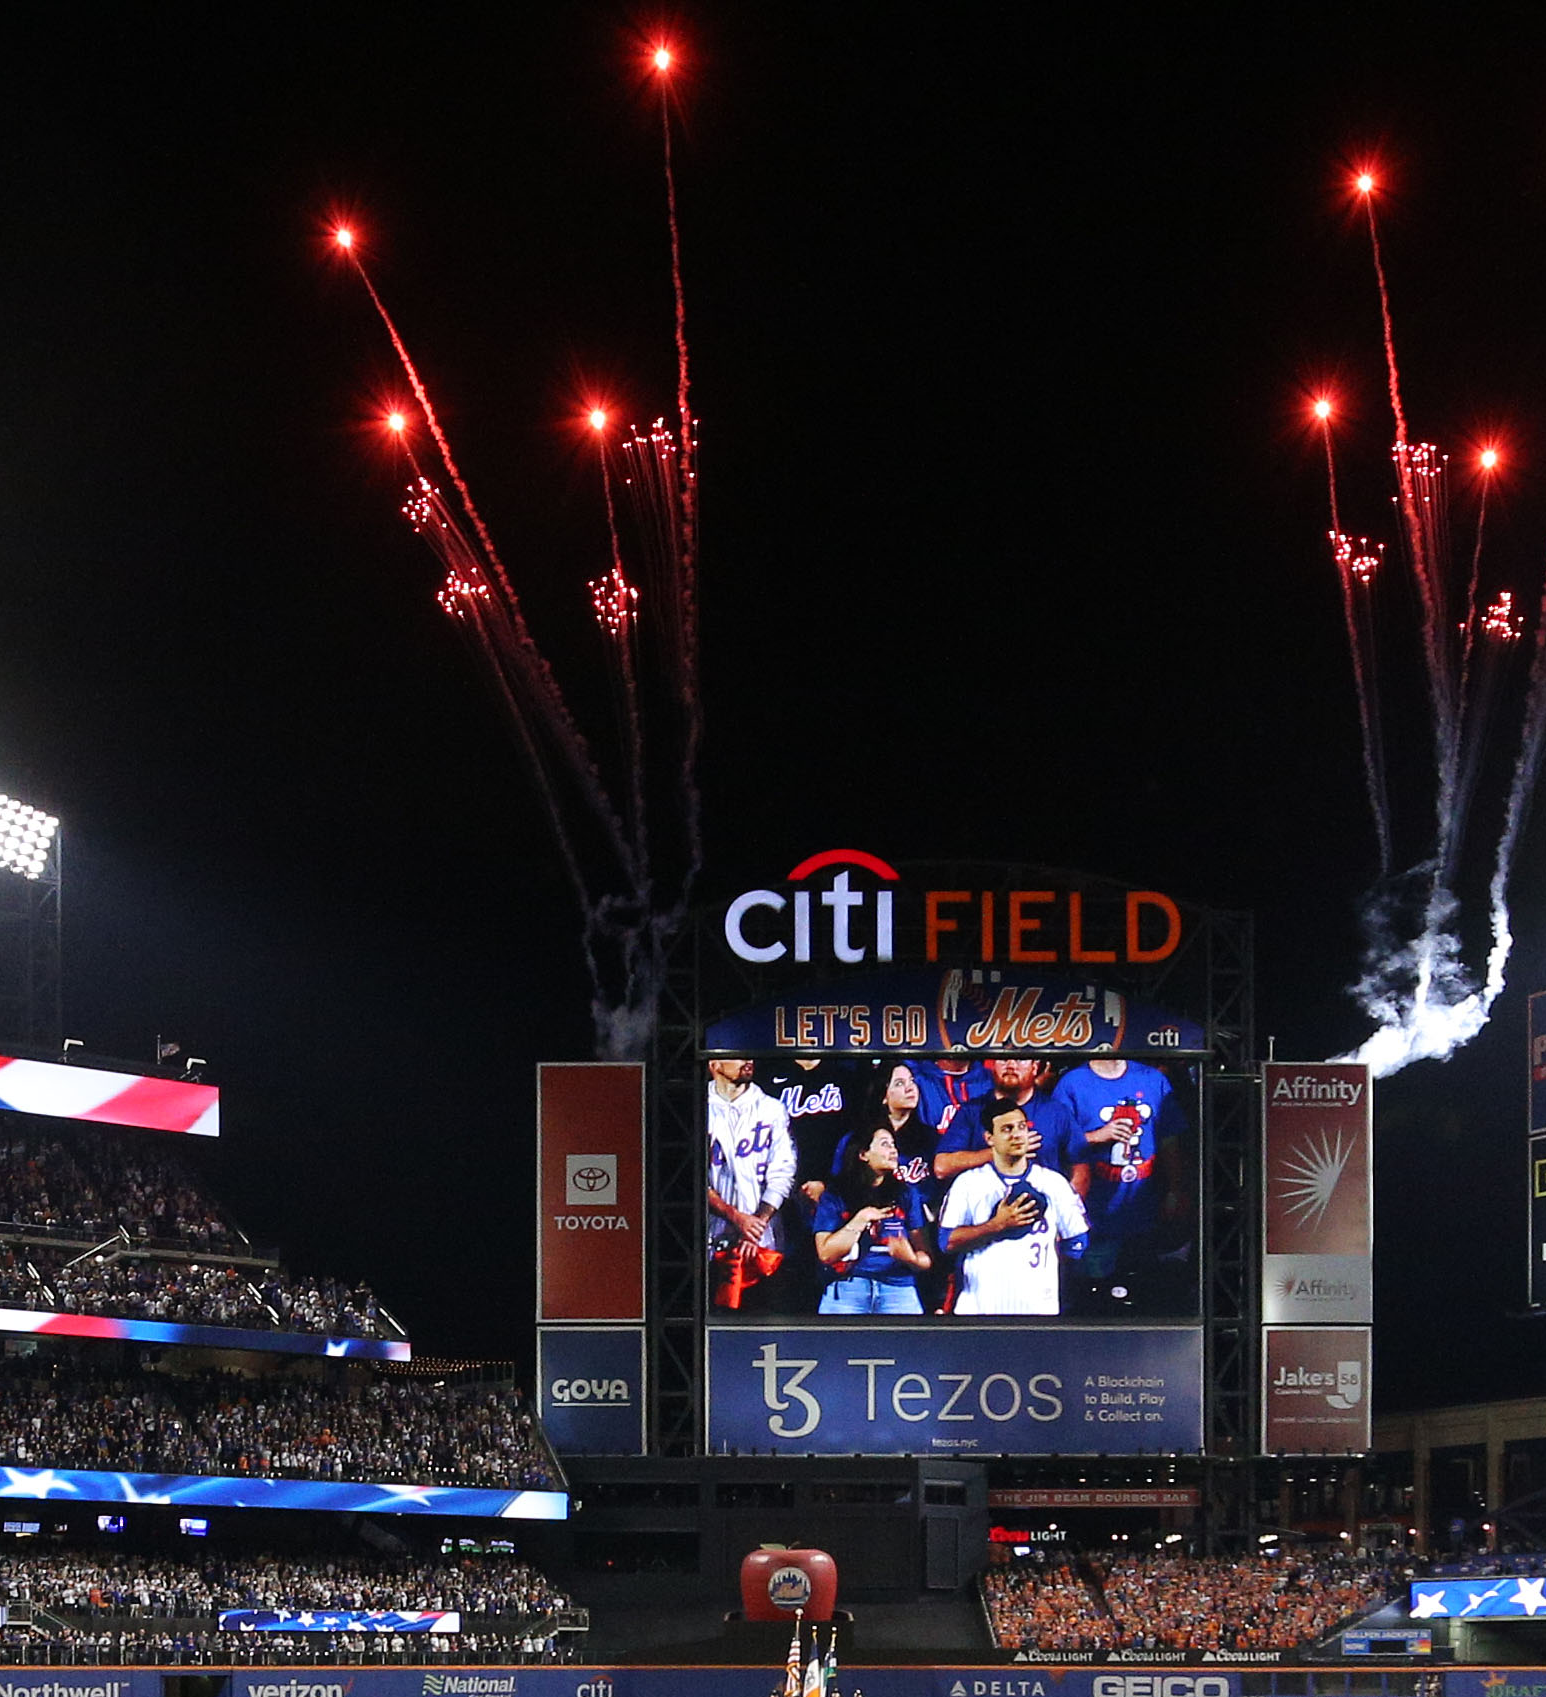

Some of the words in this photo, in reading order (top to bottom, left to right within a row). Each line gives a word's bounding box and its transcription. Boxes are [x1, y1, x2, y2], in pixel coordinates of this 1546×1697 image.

[725, 869, 894, 963] citi
[925, 890, 1181, 963] FIELD
[775, 1005, 871, 1047] LET'S
[883, 1005, 928, 1047] GO
[965, 986, 1094, 1049] Mets
[1147, 1025, 1180, 1047] citi
[1273, 1076, 1363, 1106] Affinity
[554, 1216, 629, 1230] TOYOTA
[1029, 1242, 1049, 1269] 31
[1084, 1376, 1094, 1387] A
[1097, 1375, 1165, 1388] Blockchain
[1340, 1373, 1358, 1385] 58
[552, 1379, 629, 1403] GOYA
[847, 1358, 1064, 1422] Tezos
[1084, 1393, 1097, 1405] to
[1101, 1392, 1135, 1407] Build,
[1139, 1392, 1166, 1409] Play
[1084, 1410, 1094, 1422] &
[1098, 1409, 1142, 1422] Collect
[996, 1494, 1021, 1503] THE
[1026, 1494, 1048, 1503] JIM
[1054, 1494, 1090, 1503] BEAM
[1096, 1494, 1157, 1503] BOURBON
[1163, 1494, 1189, 1503] BAR
[1030, 1530, 1067, 1542] LIGHT
[1062, 1652, 1094, 1663] LIGHT
[1155, 1652, 1186, 1663] LIGHT
[1249, 1652, 1281, 1663] LIGHT
[974, 1681, 1046, 1697] DELTA
